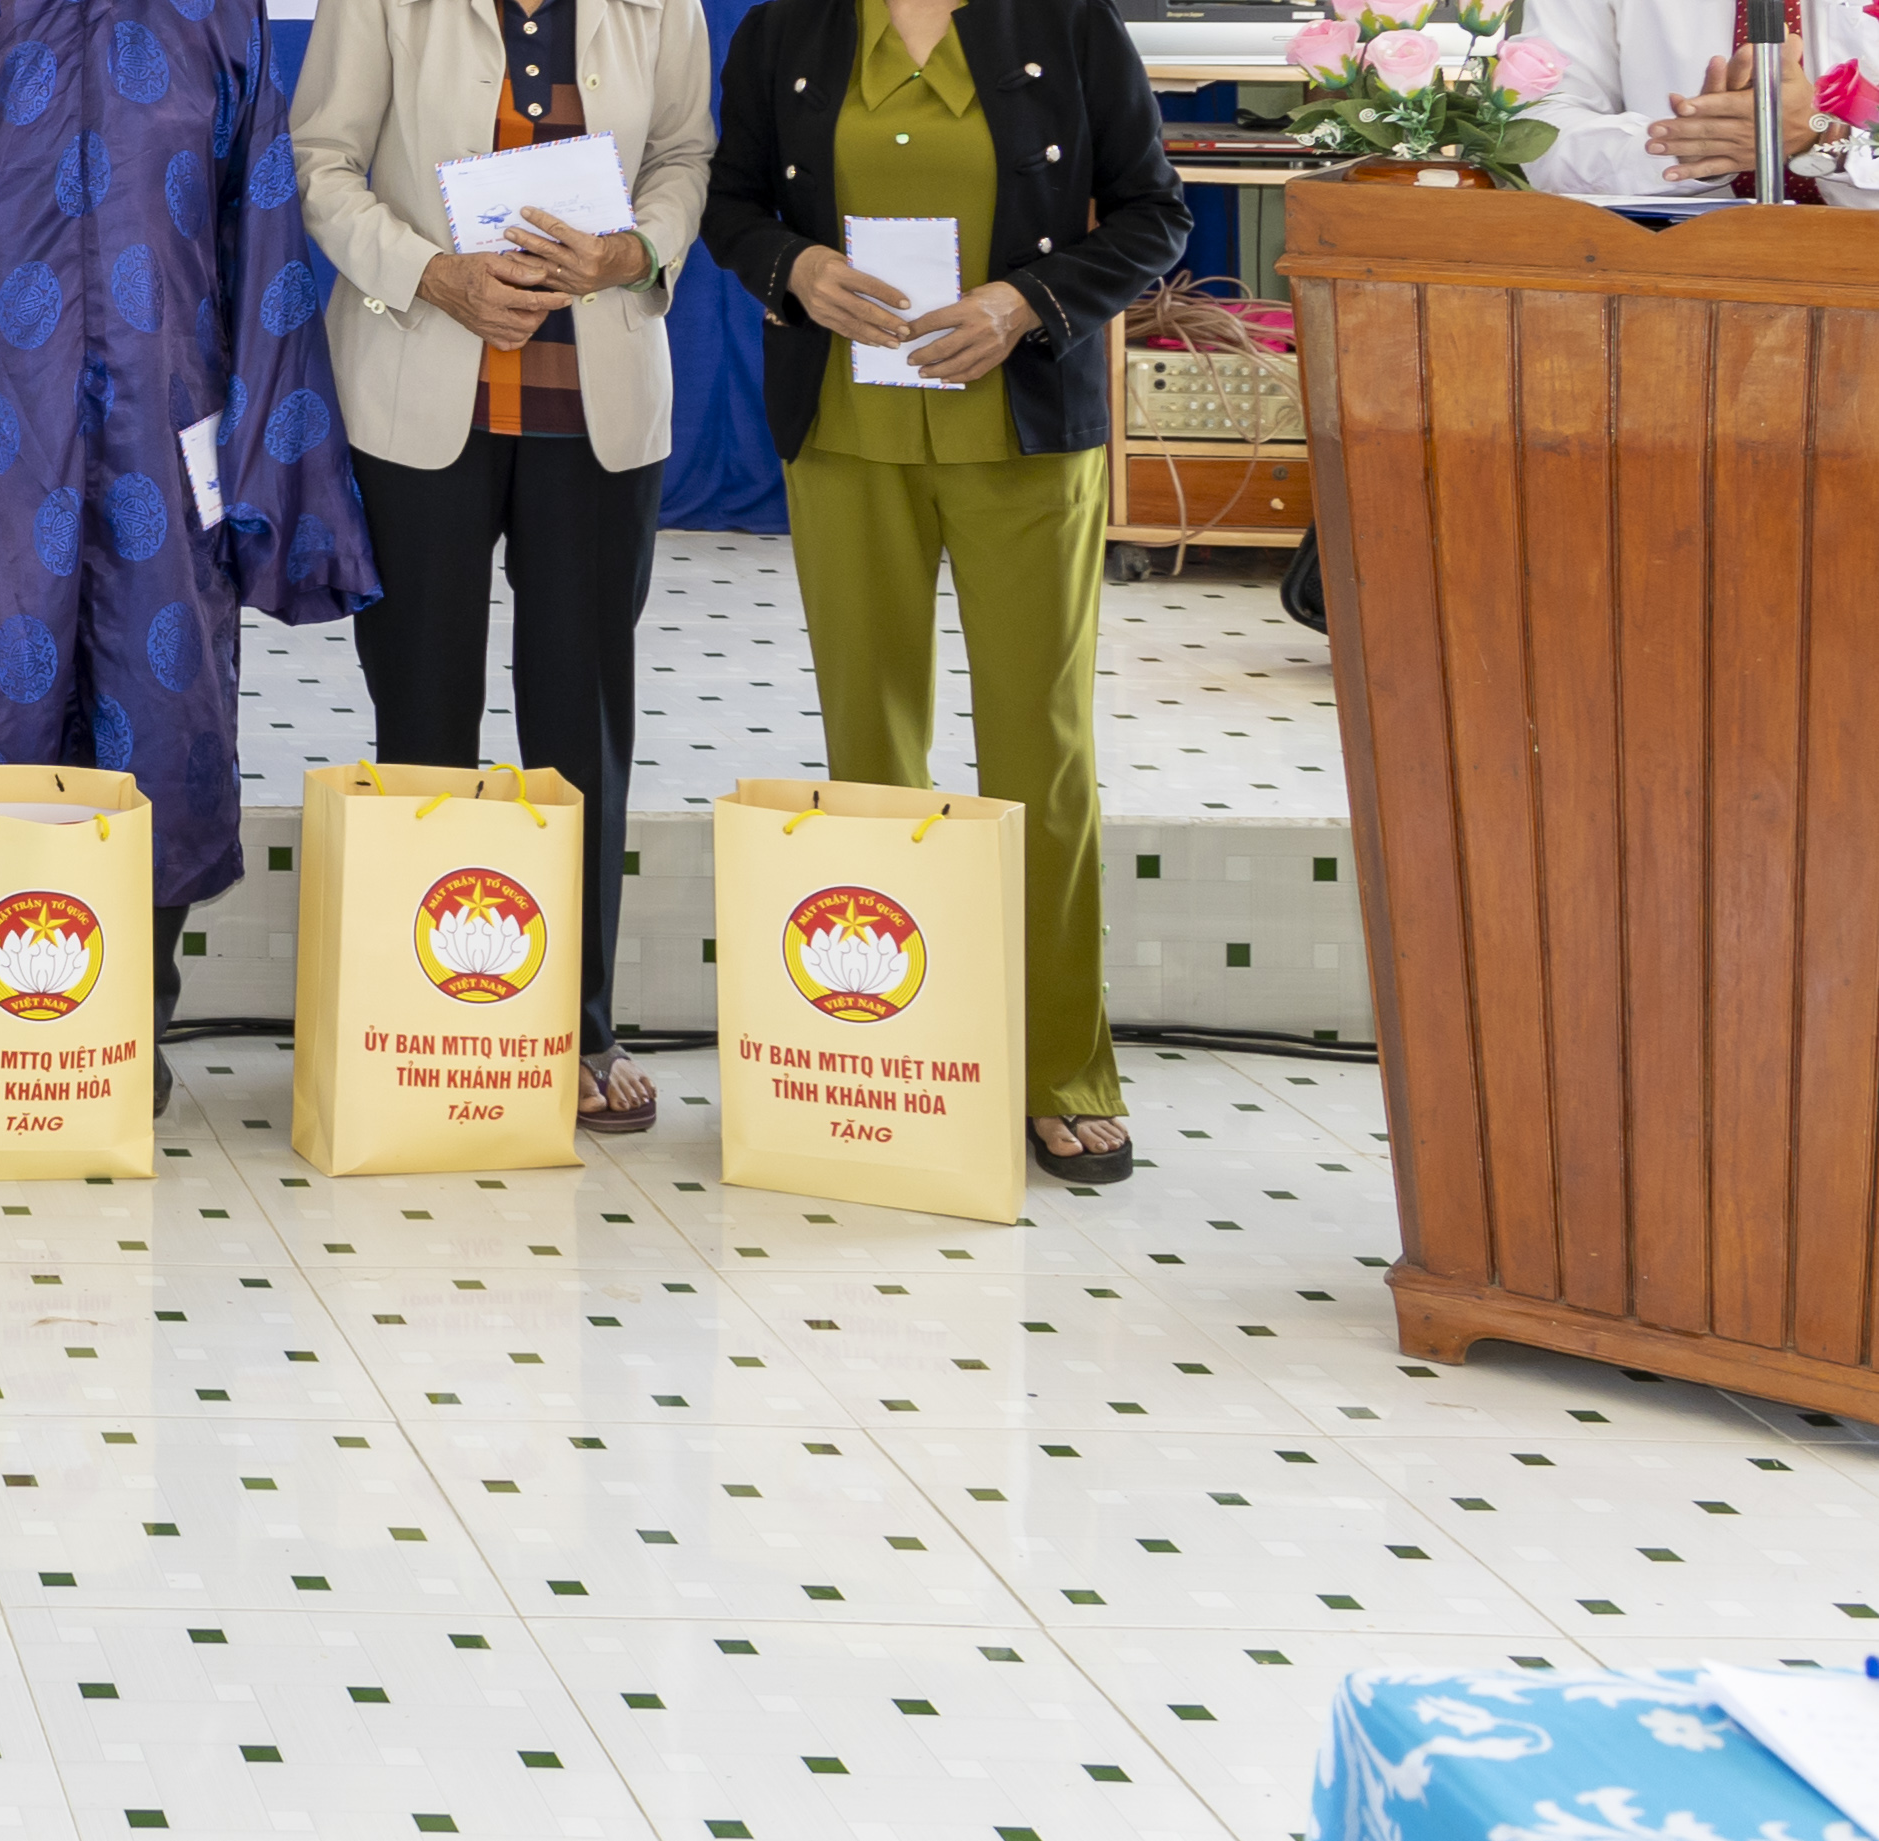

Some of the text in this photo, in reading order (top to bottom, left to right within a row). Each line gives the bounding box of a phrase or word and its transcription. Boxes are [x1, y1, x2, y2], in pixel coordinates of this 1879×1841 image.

[1, 1051, 52, 1072] MTTQ
[60, 1045, 96, 1073] VIỆT
[102, 1039, 136, 1065] NAM
[365, 1025, 573, 1063] ỦY BAN MTTQ VIỆT NAM
[740, 1033, 980, 1084] ỦY BAN MTTQ VIỆT NAM
[5, 1076, 70, 1101] KHÁNH
[77, 1074, 111, 1100] HÒA
[397, 1062, 552, 1090] TỈNH KHÁNH HÒA
[773, 1073, 946, 1115] TỈNH KHÁNH HÒA
[7, 1112, 63, 1136] TẶNG
[449, 1101, 503, 1124] TẶNG
[831, 1118, 892, 1143] TẶNG
